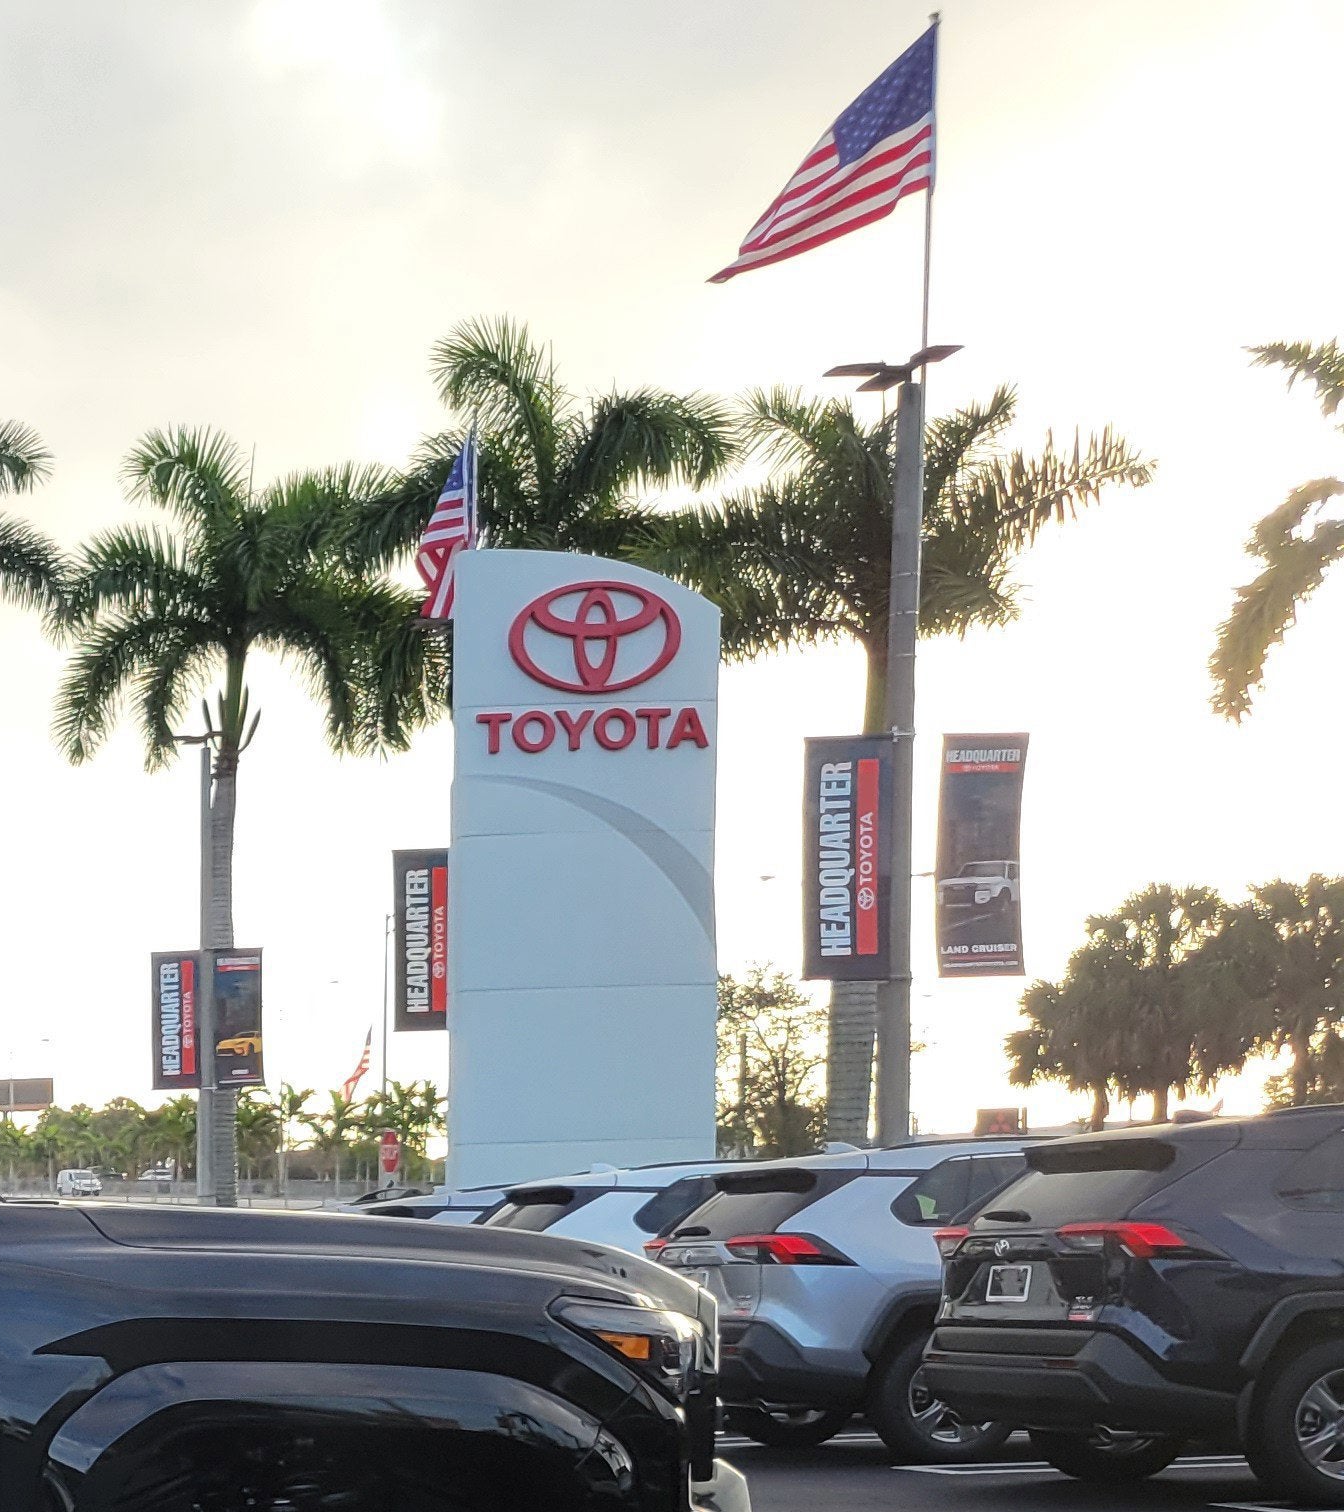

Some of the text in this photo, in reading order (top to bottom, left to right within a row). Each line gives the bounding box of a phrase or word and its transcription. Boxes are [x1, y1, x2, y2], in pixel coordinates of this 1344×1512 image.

[476, 706, 709, 754] TOYOTA
[946, 748, 1021, 764] HEADQUARTER
[819, 760, 853, 958] HEADQUARTER
[858, 811, 874, 886] TOYOTA
[406, 867, 430, 1014] HEADQUARTER
[433, 905, 445, 961] TOYOTA
[940, 943, 1017, 956] LAND CRUISER
[160, 962, 181, 1076] HEADQUARTER
